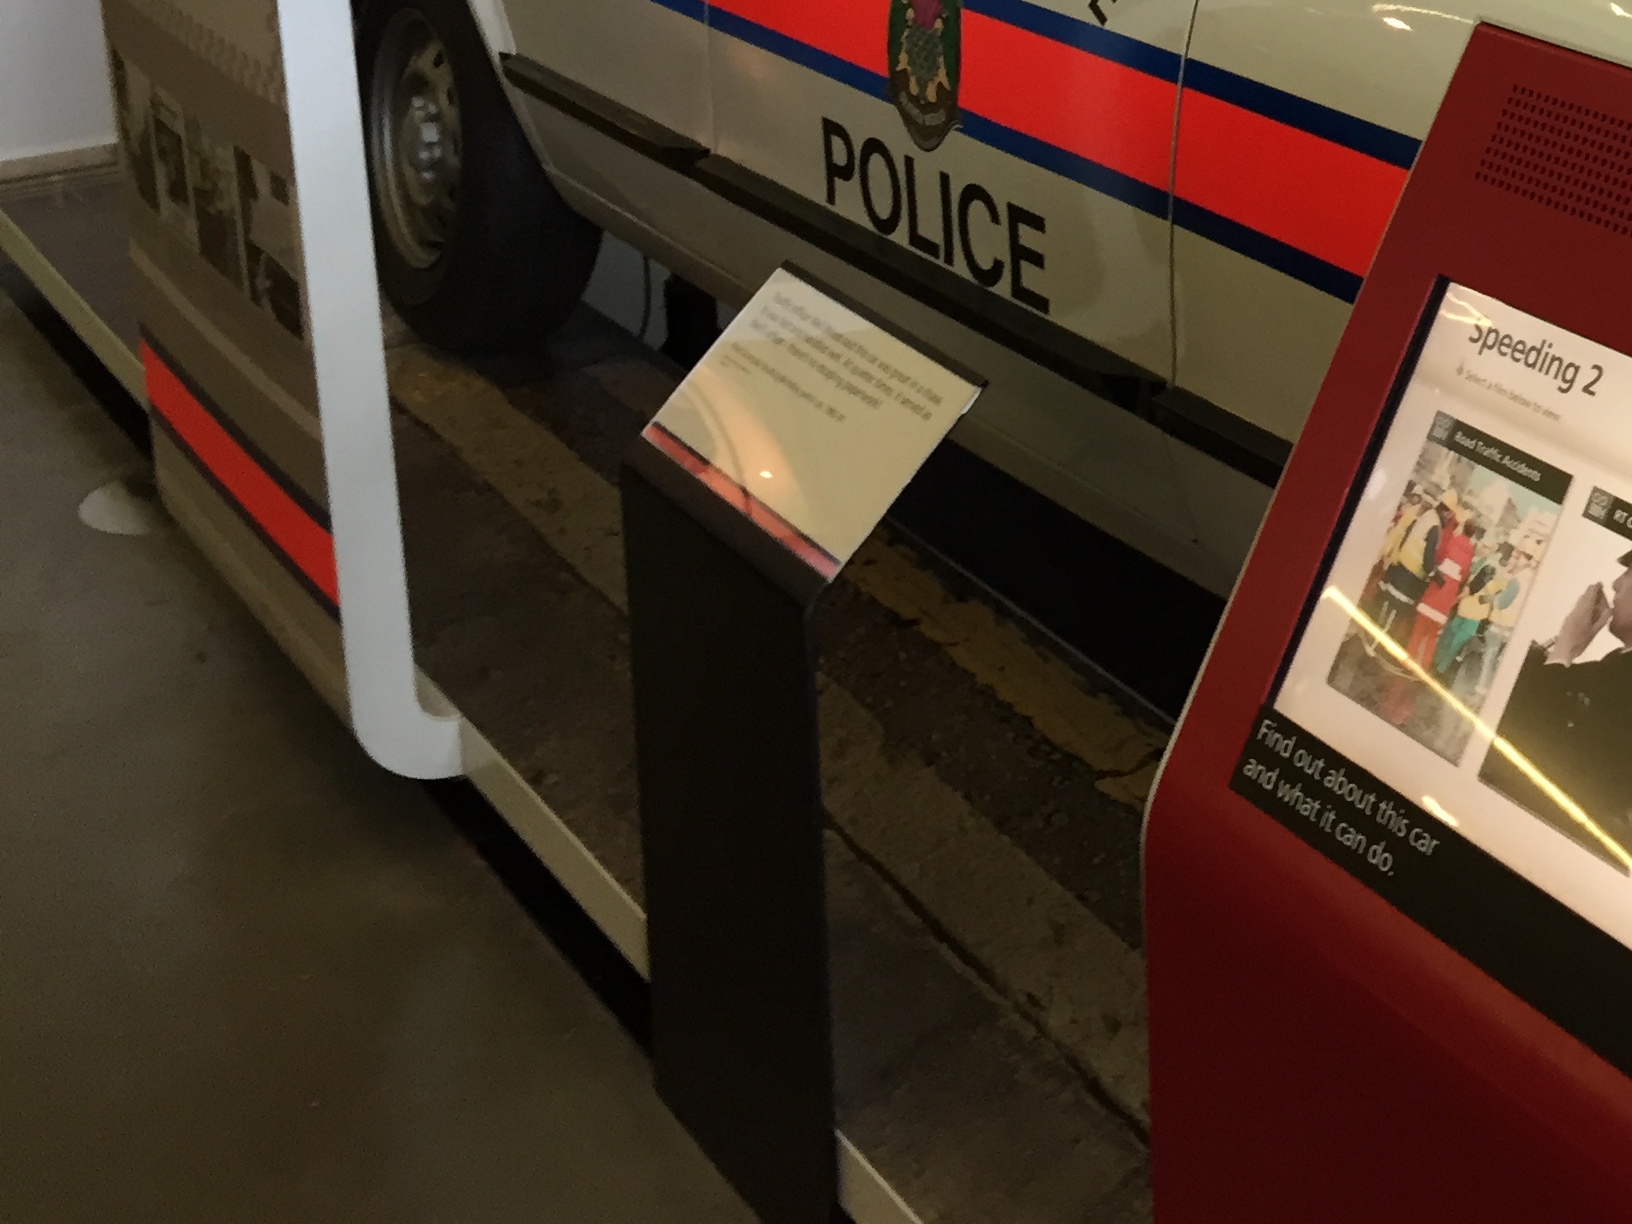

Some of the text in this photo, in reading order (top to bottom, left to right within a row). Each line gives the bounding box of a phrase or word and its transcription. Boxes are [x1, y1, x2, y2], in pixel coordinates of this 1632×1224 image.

[821, 116, 1051, 315] POLICE
[1468, 322, 1604, 397] Speeding 2
[1500, 455, 1541, 483] Accidents
[1243, 758, 1394, 876] and what it can do.
[1256, 719, 1440, 855] Find out about this car
